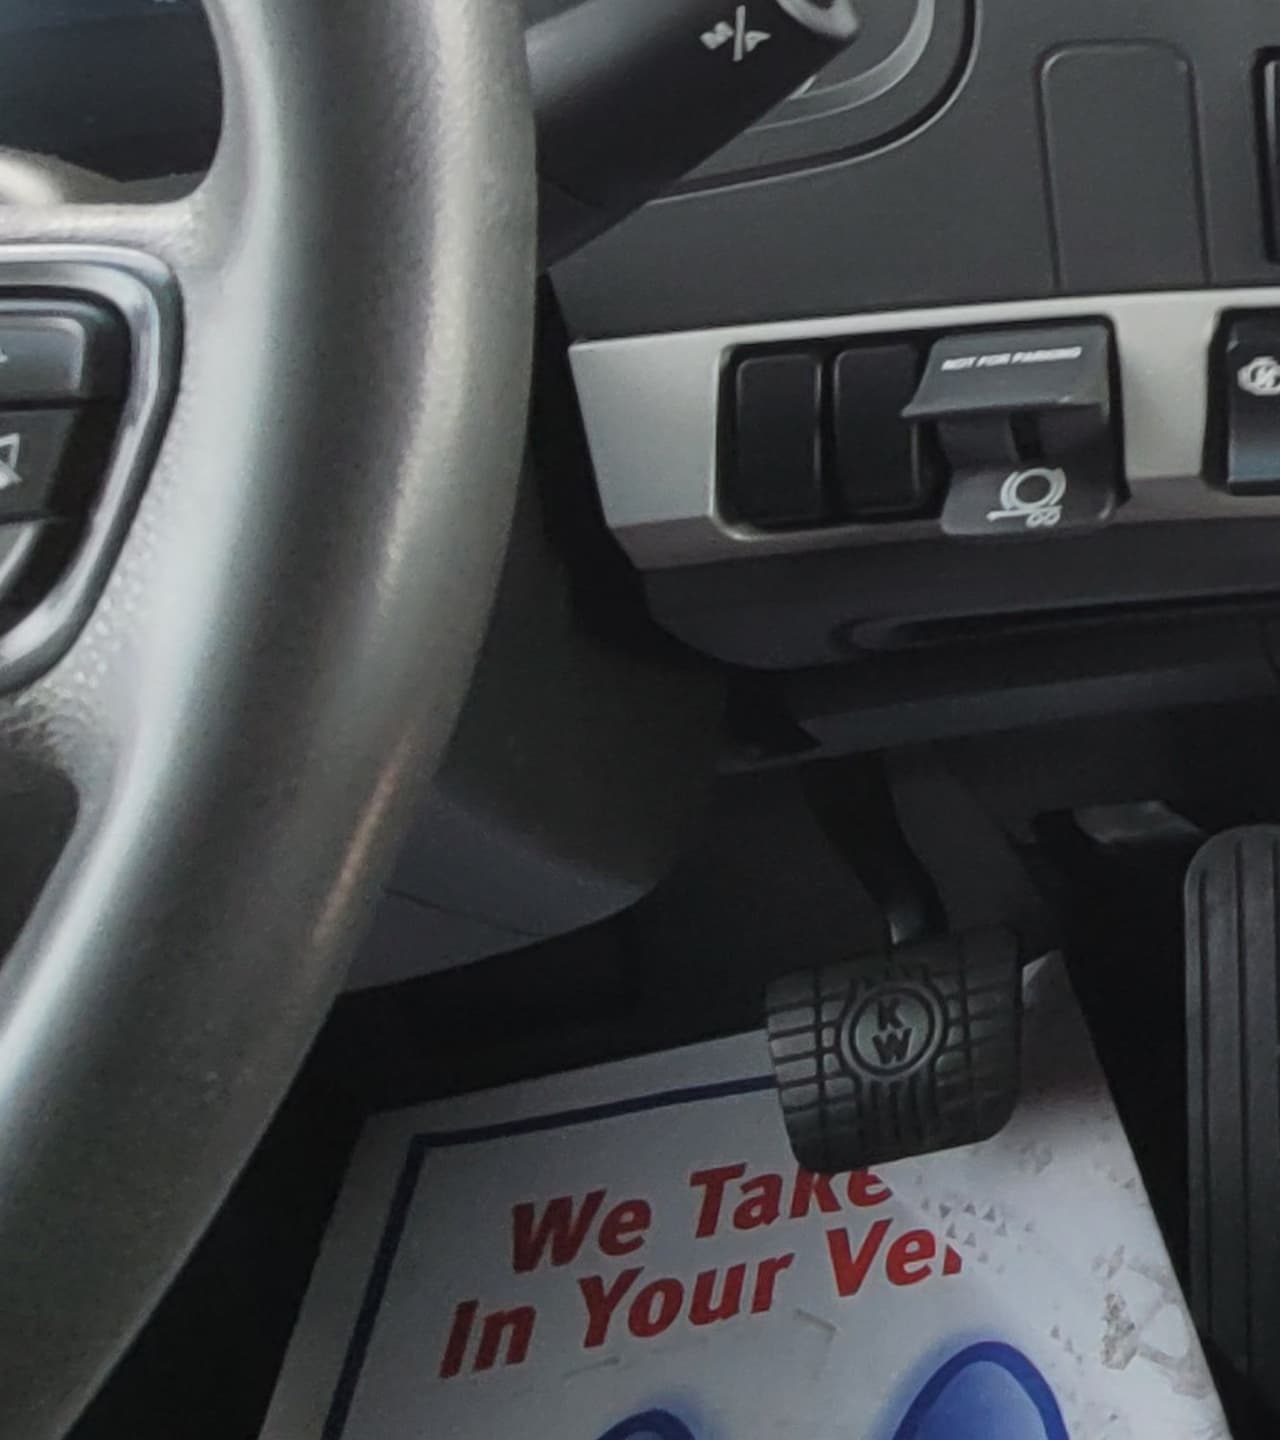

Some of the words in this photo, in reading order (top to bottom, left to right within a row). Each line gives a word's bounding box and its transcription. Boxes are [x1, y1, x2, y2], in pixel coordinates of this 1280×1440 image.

[940, 356, 977, 372] NOT
[976, 352, 1012, 368] FOR
[1010, 345, 1083, 365] PARKING
[876, 998, 905, 1031] K
[871, 1028, 913, 1065] W
[509, 1187, 653, 1274] We
[439, 1297, 536, 1380] In
[577, 1251, 796, 1350] Your
